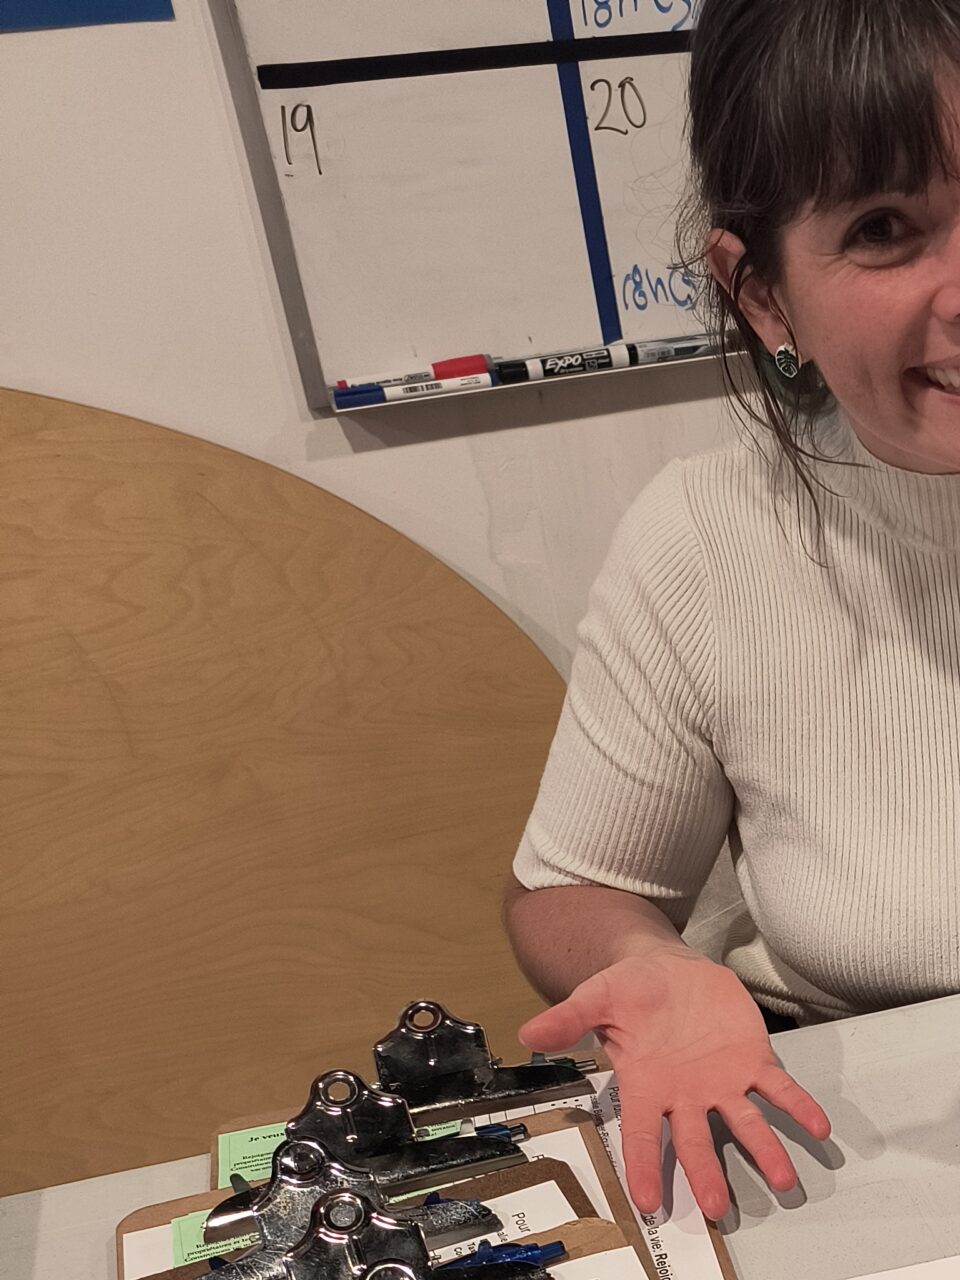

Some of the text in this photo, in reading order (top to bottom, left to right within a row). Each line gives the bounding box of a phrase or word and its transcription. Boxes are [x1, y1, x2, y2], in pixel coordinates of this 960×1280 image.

[591, 76, 647, 134] 20
[281, 103, 322, 176] 19
[546, 356, 582, 373] EXPO
